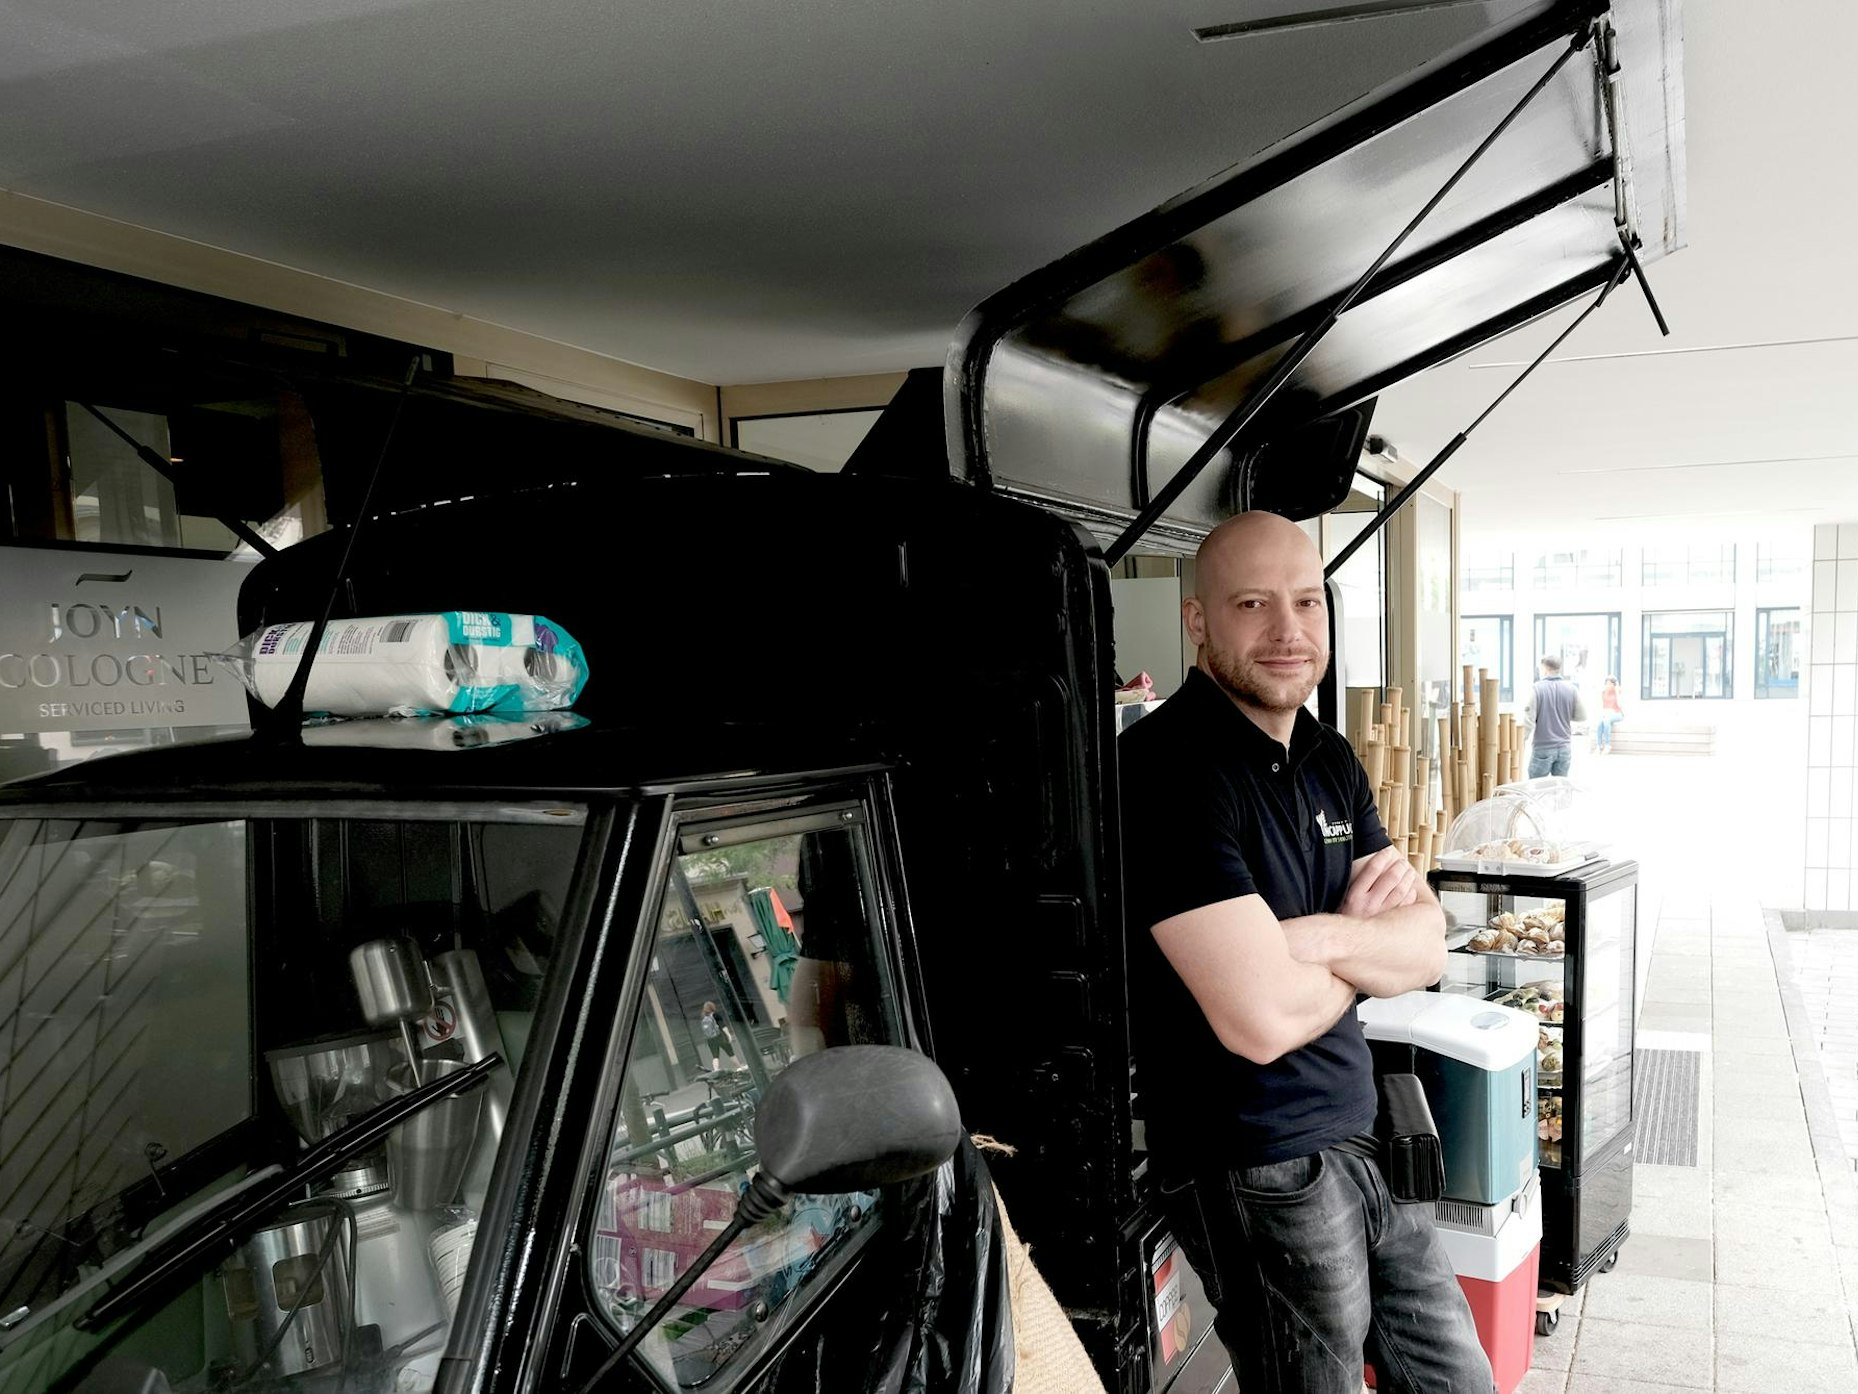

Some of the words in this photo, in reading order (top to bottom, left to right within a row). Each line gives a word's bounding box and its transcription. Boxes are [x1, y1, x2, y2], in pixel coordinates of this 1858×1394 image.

[50, 603, 163, 643] JOYN
[463, 612, 491, 625] DICK
[463, 625, 502, 638] DURSTIG
[259, 630, 280, 655] DICK
[0, 654, 215, 689] COLOGNE
[39, 701, 125, 718] SERVICED
[131, 700, 185, 715] LIVING
